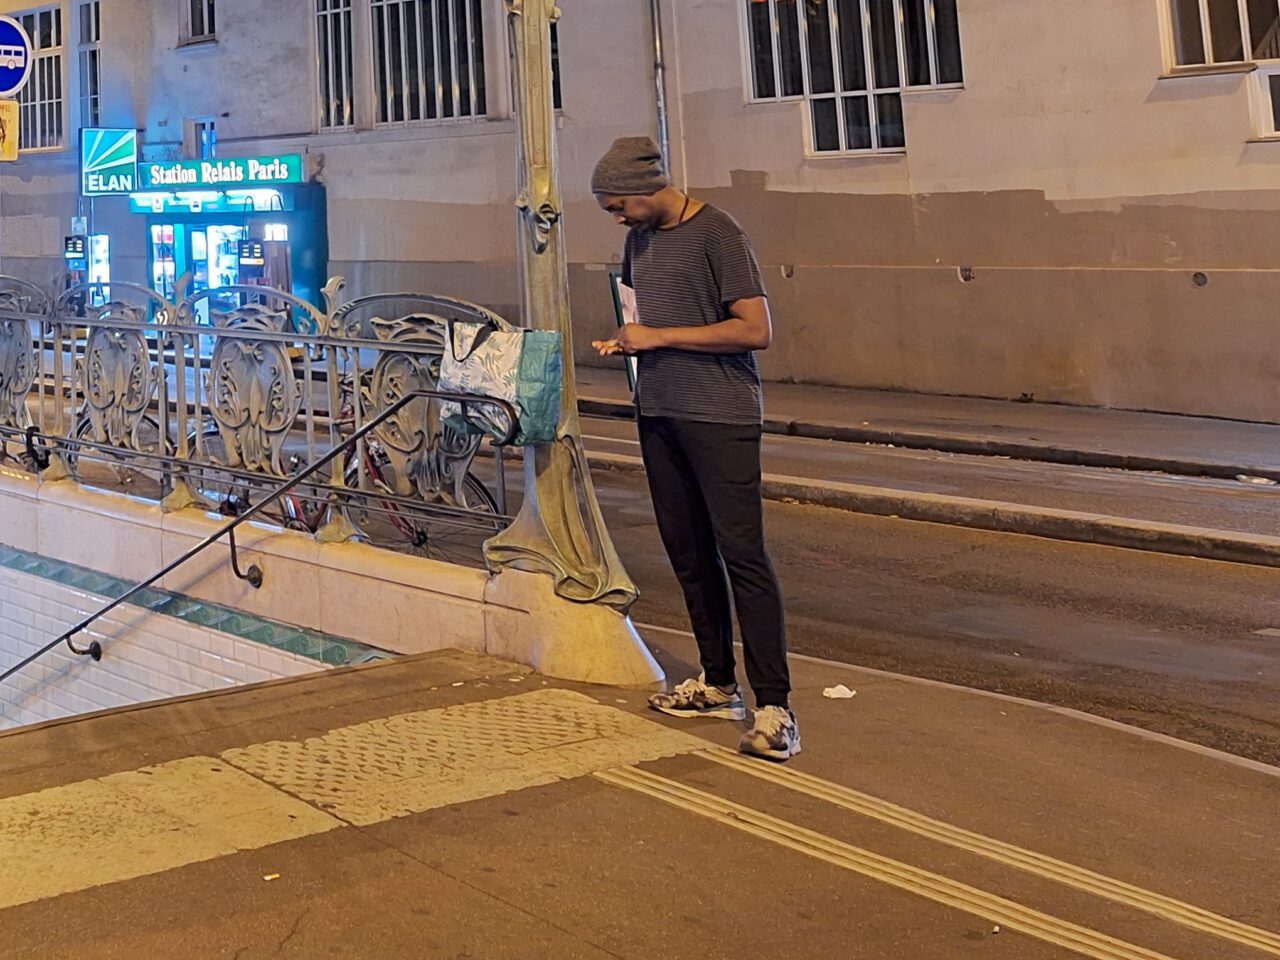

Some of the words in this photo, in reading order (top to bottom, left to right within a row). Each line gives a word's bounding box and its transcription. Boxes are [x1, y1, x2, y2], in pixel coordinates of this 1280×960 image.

[151, 164, 197, 184] Station
[201, 161, 243, 184] Relais
[248, 158, 288, 181] Paris
